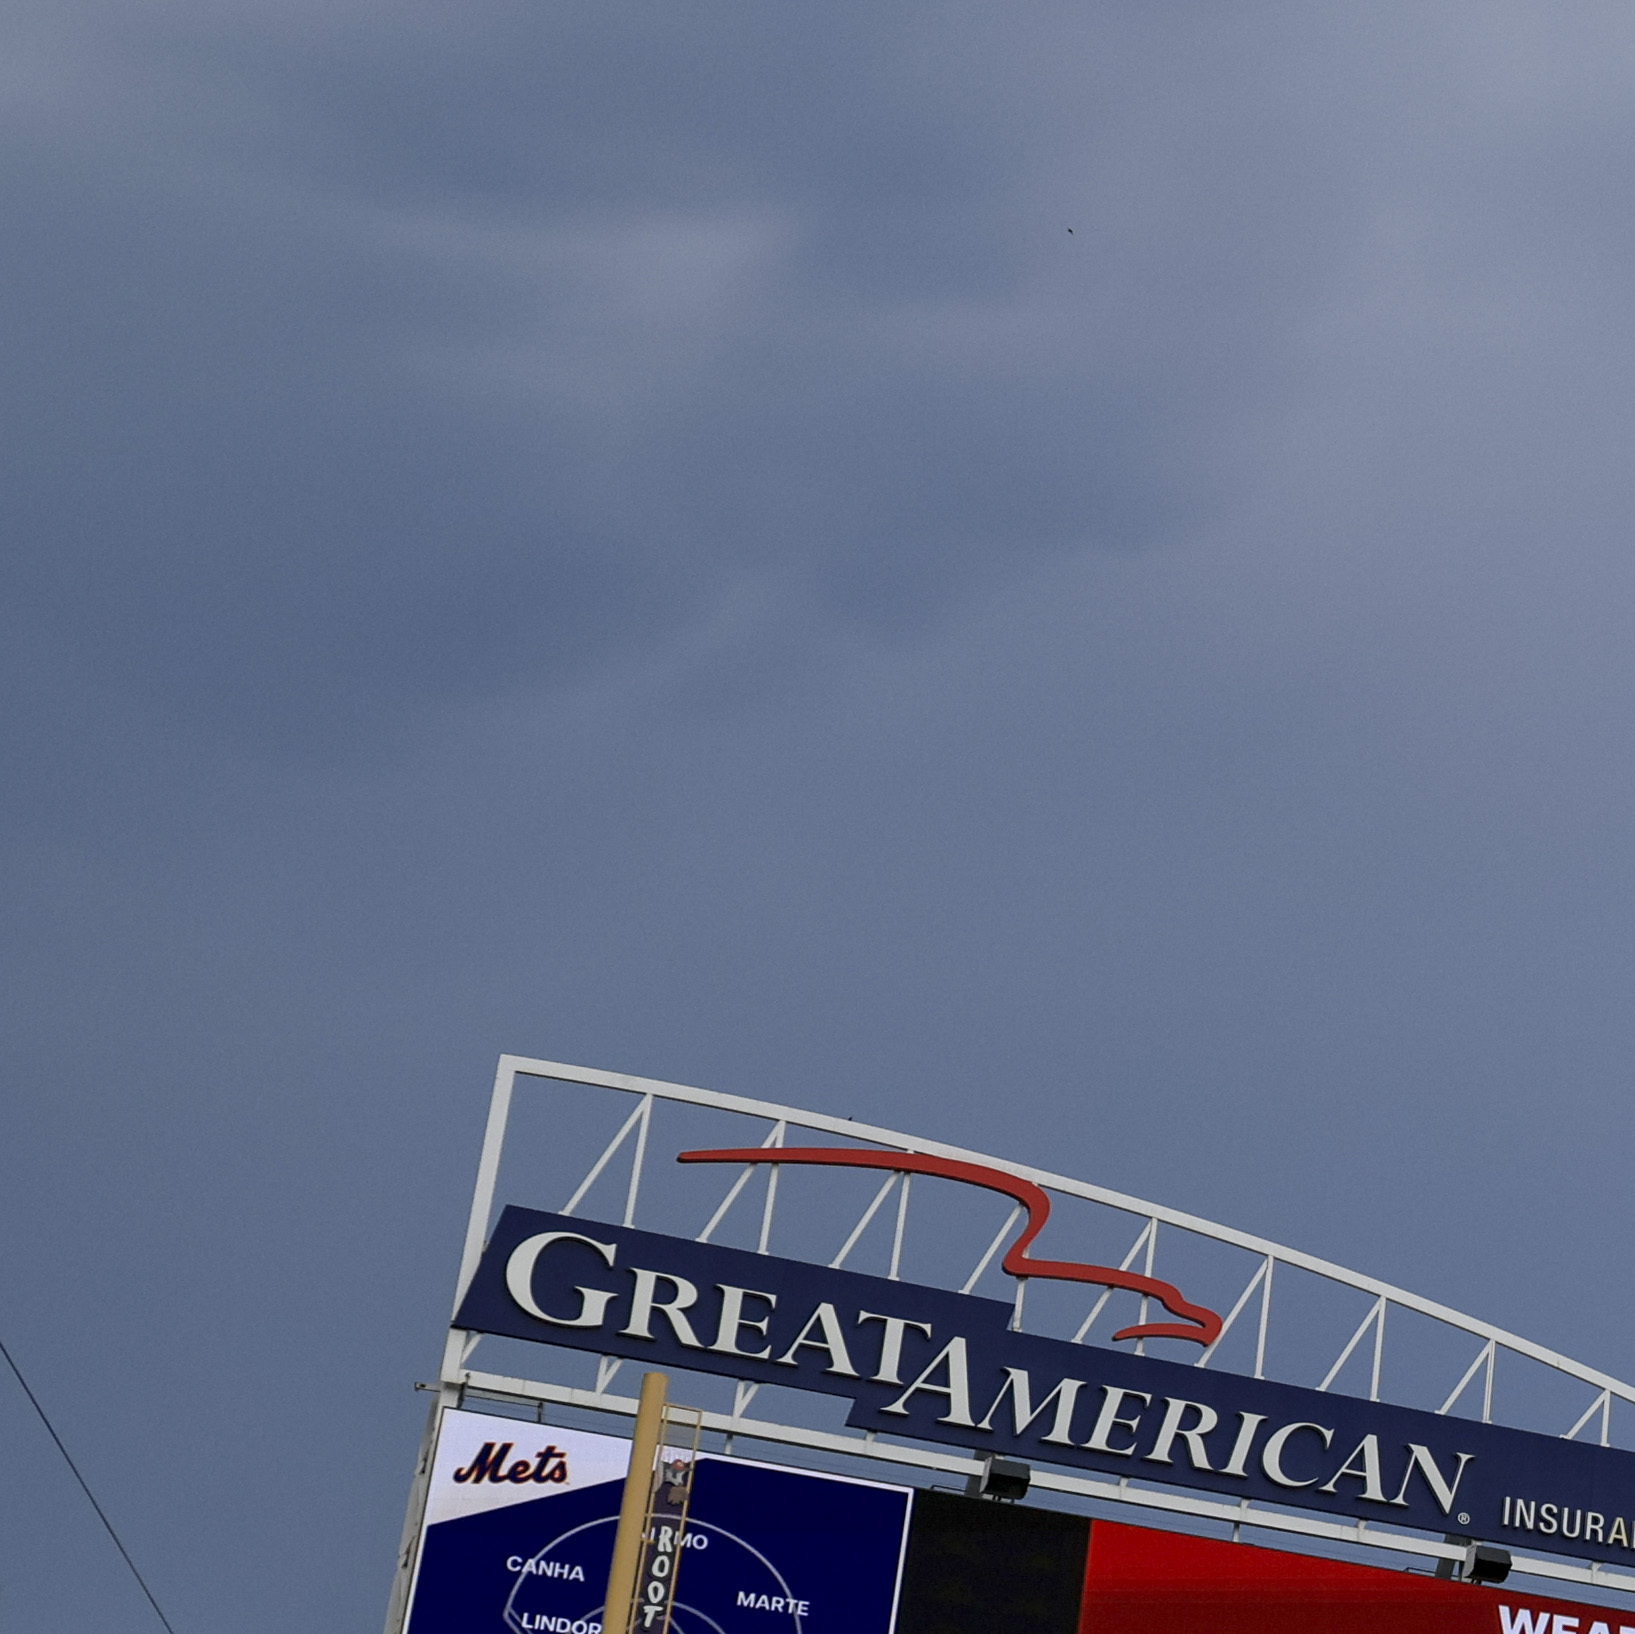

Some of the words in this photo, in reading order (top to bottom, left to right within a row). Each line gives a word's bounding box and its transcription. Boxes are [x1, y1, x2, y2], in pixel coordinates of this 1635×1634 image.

[505, 1230, 931, 1383] GREAT
[880, 1335, 1475, 1517] AMERICAN
[453, 1442, 570, 1484] Mets
[506, 1556, 585, 1582] CANHA
[644, 1525, 673, 1628] ROOT
[737, 1591, 809, 1616] MARTE
